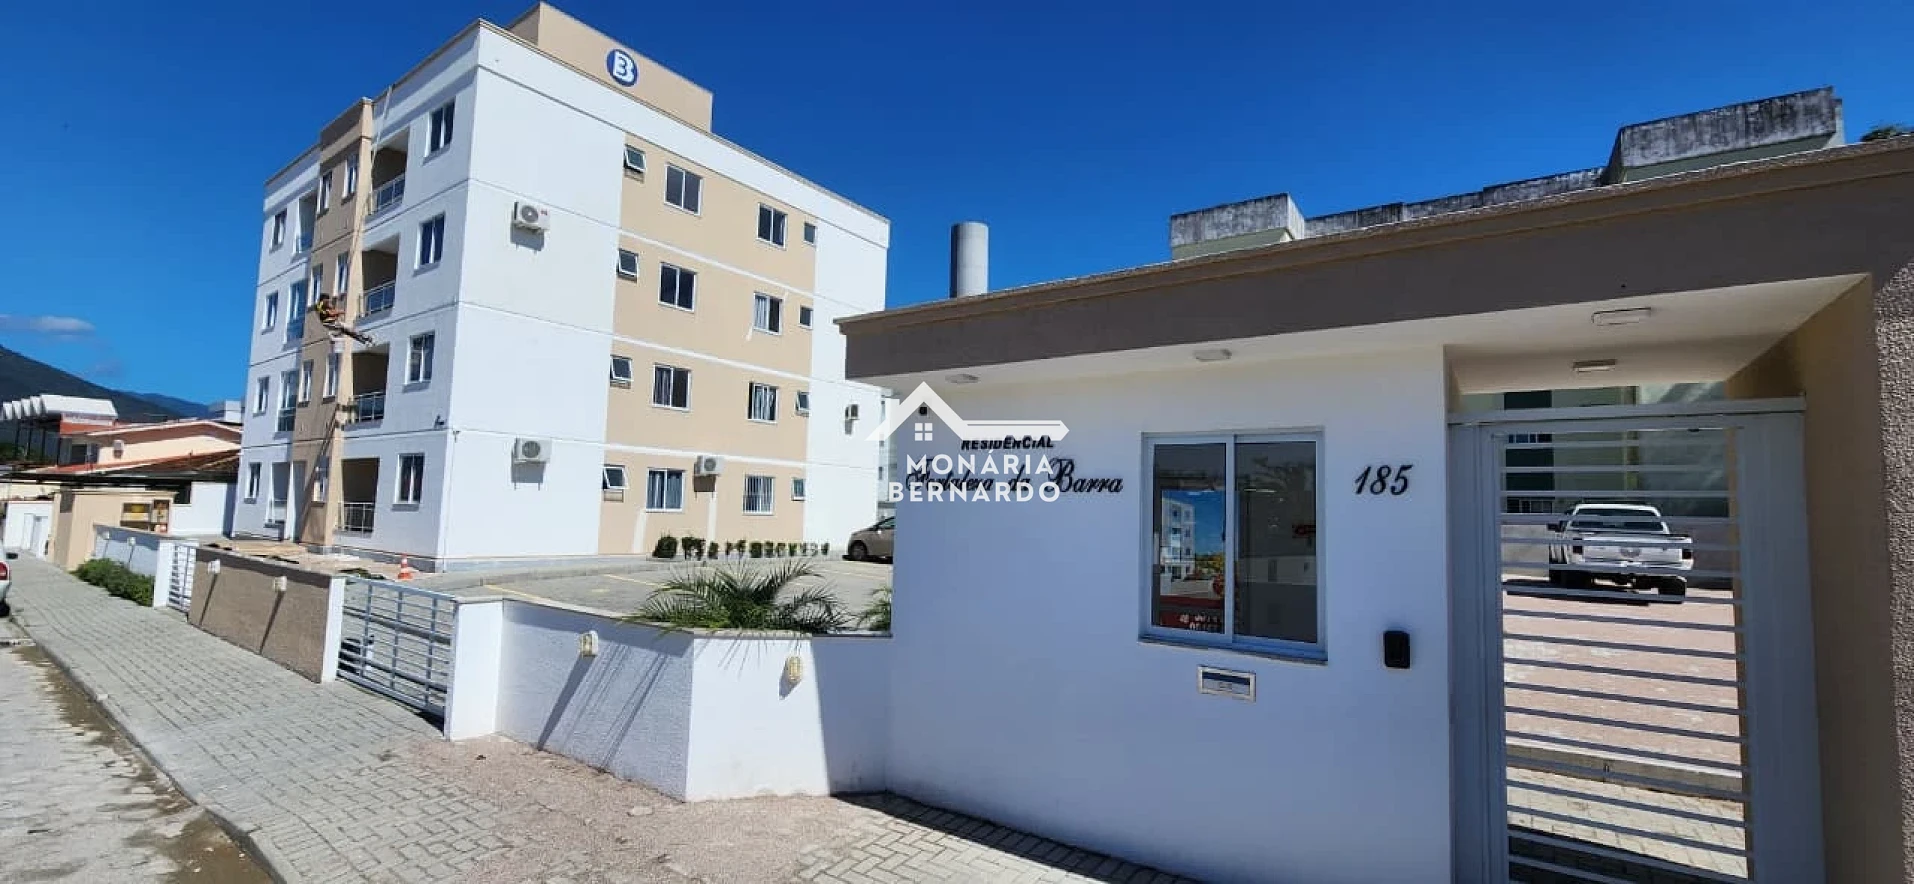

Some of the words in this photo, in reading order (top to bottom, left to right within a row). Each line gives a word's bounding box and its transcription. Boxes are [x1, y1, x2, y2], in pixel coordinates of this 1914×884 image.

[961, 435, 1053, 450] RESIDENCIAL
[1048, 458, 1123, 493] Barra
[1355, 465, 1413, 495] 185
